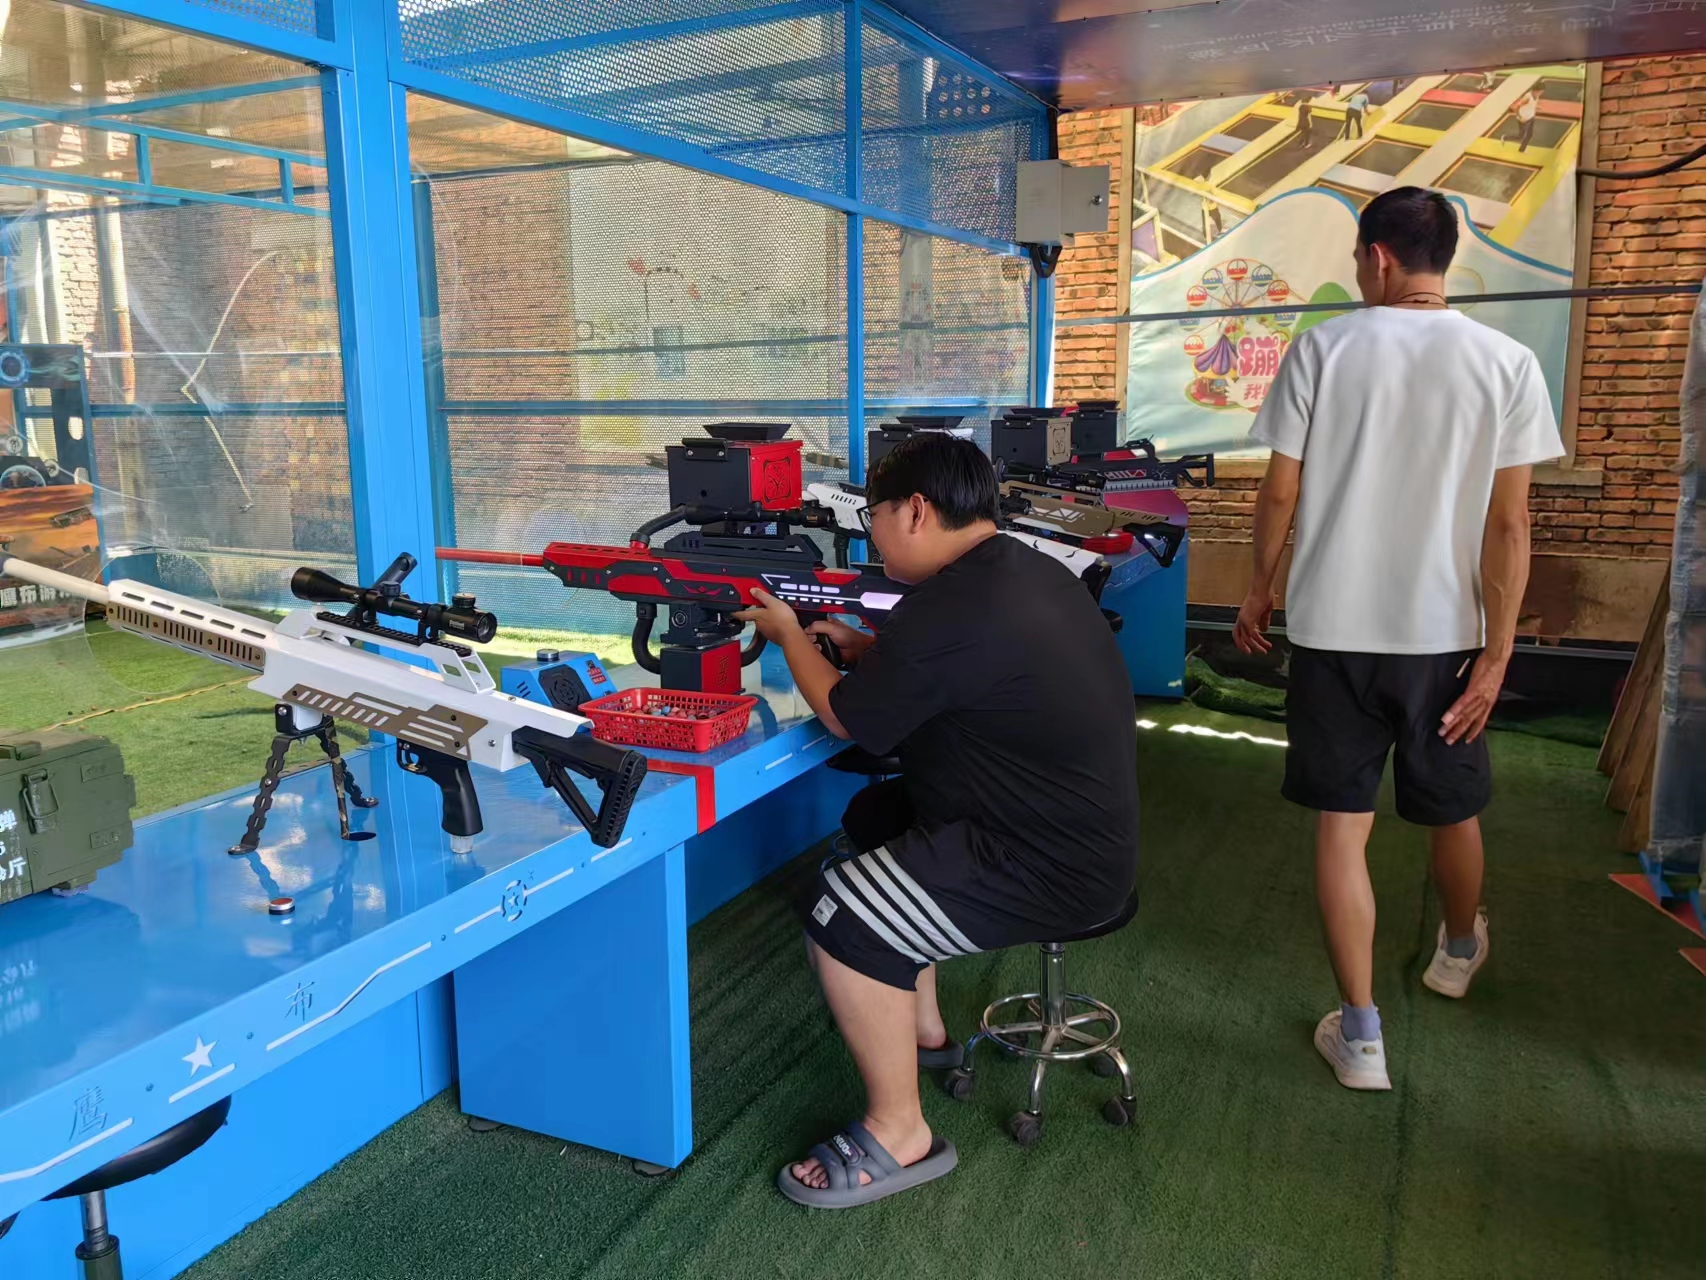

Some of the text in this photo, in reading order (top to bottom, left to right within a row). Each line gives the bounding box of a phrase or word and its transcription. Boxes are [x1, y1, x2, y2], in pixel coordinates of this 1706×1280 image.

[1238, 336, 1280, 377] 蹦
[69, 981, 316, 1141] 鹰 布
